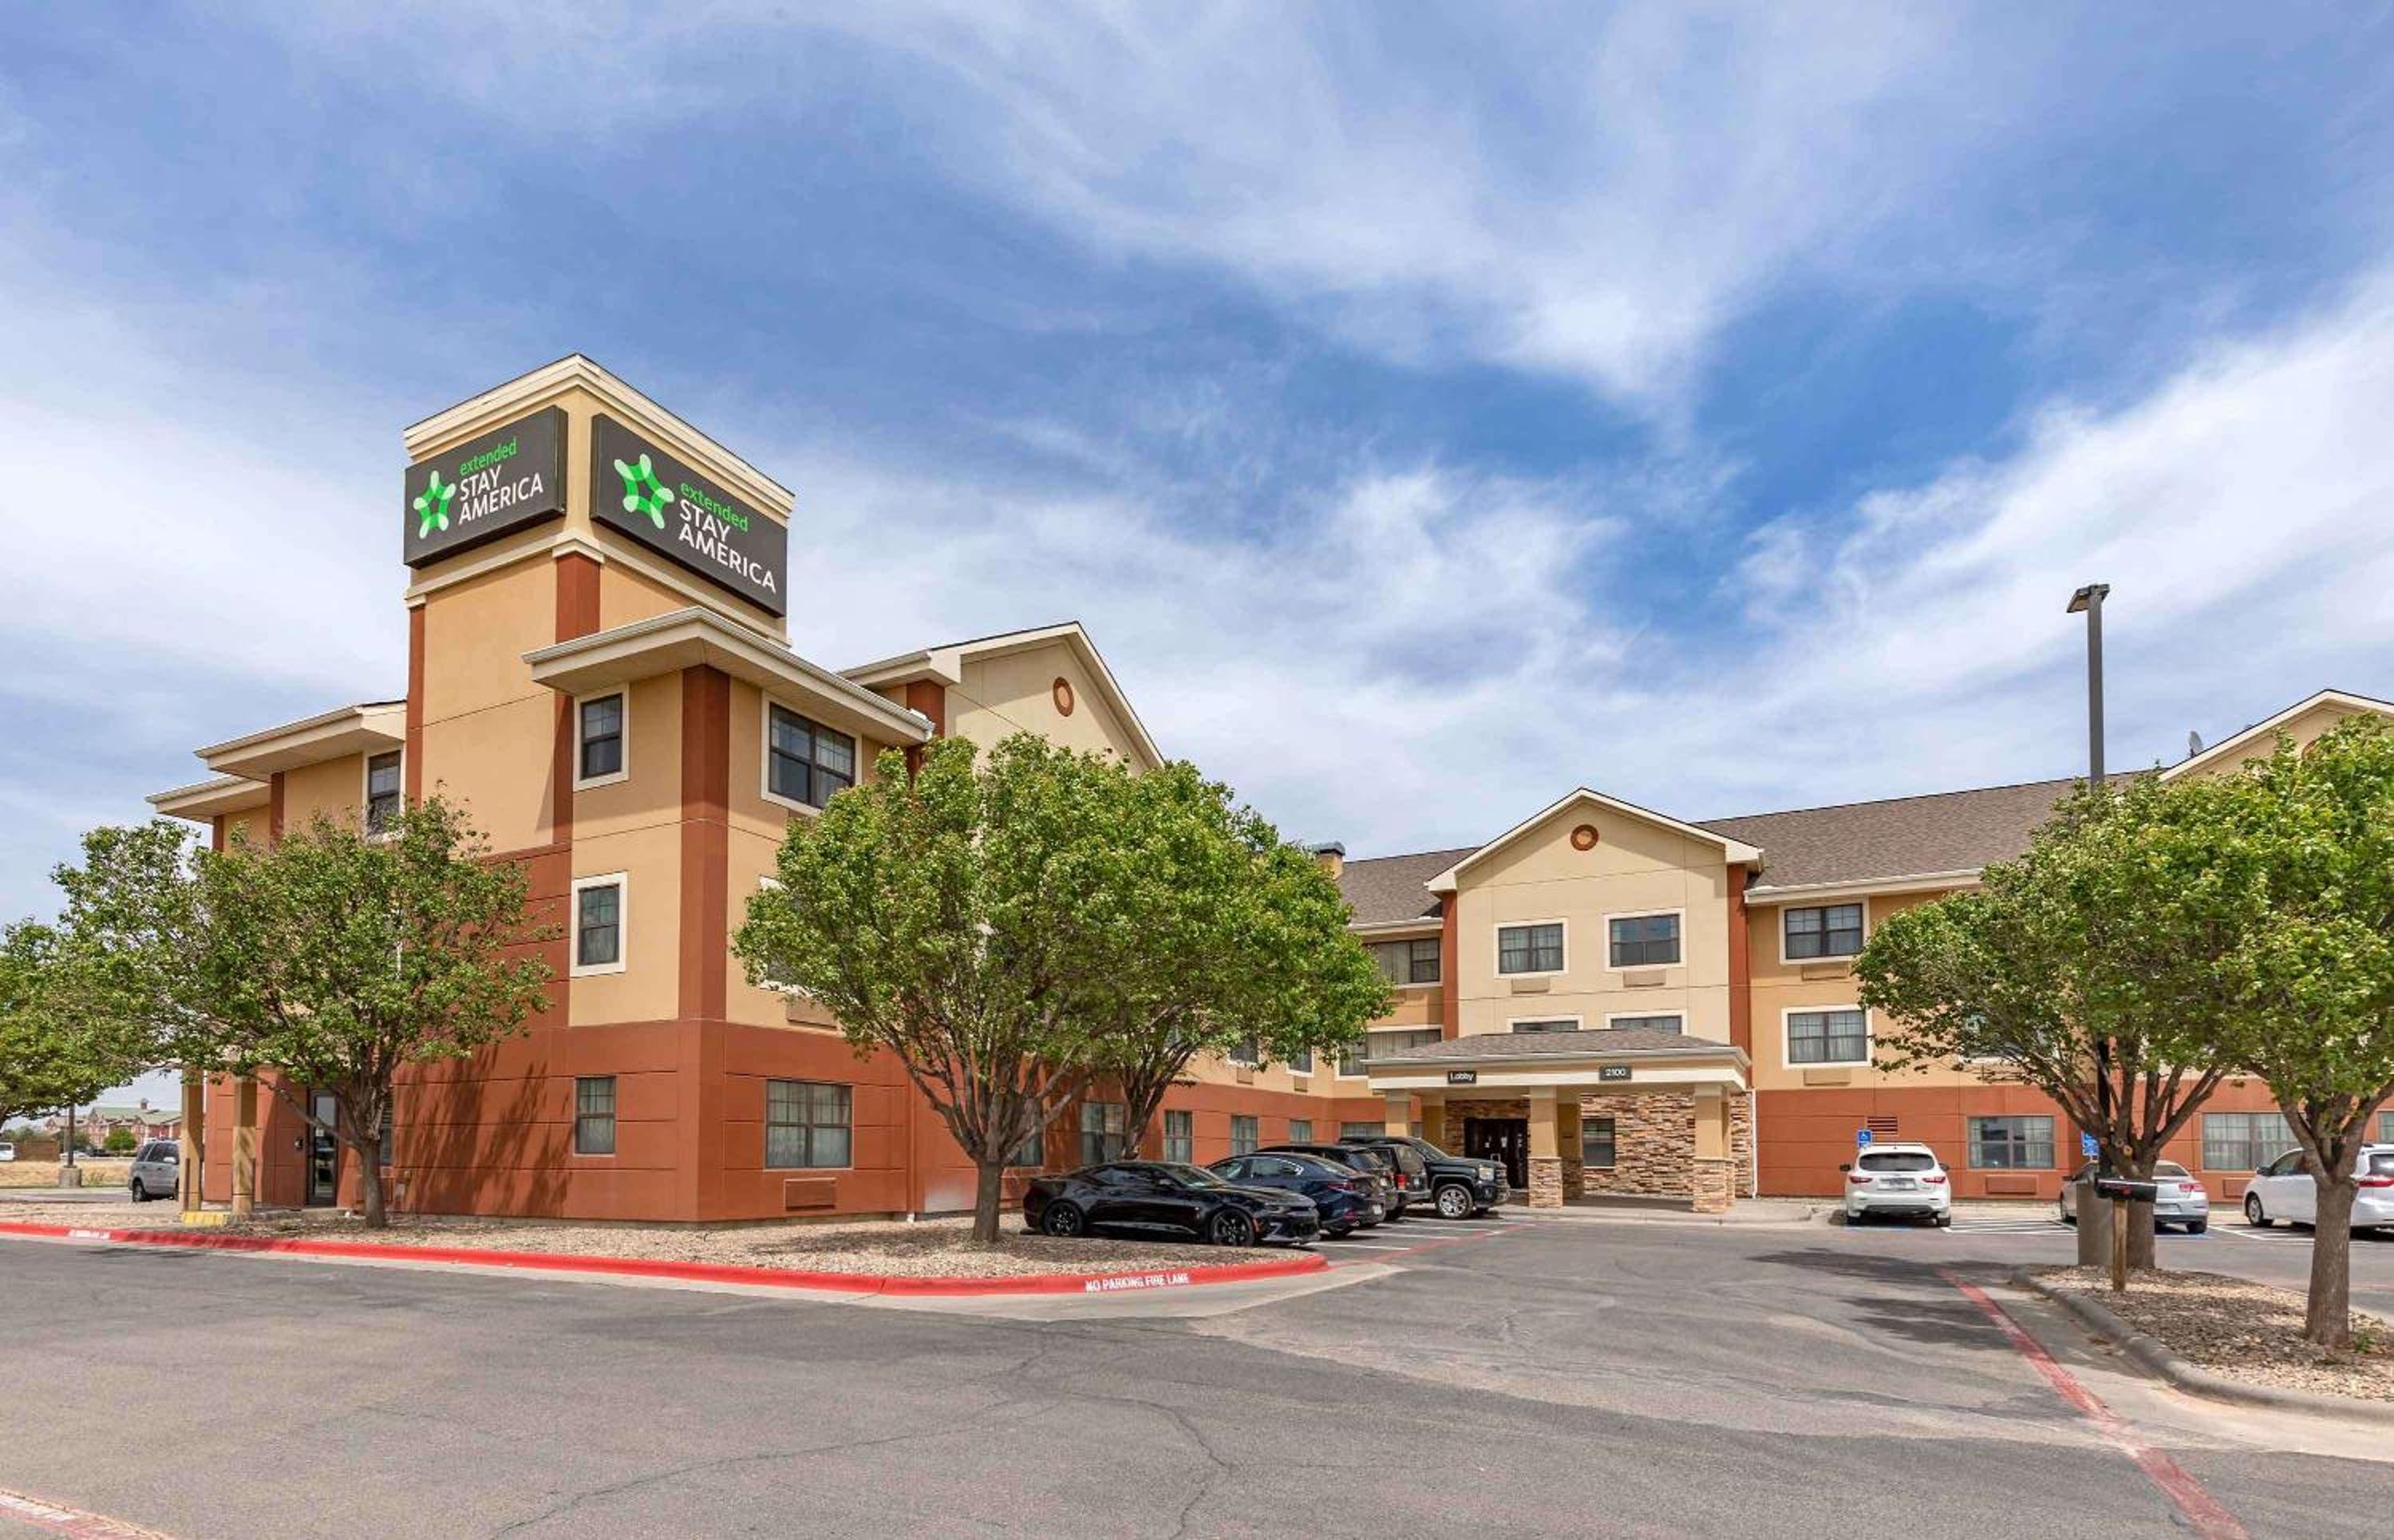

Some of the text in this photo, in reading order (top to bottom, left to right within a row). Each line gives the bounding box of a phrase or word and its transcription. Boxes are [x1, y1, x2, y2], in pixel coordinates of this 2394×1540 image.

[460, 436, 517, 476] extended
[458, 472, 543, 524] AMERICA
[460, 464, 501, 501] STAY
[679, 499, 730, 542] STAY
[681, 483, 748, 532] extended
[678, 523, 776, 594] AMERICA
[1450, 1072, 1474, 1081] Lobby
[1085, 1273, 1189, 1292] NO PARKING FIRE LANE
